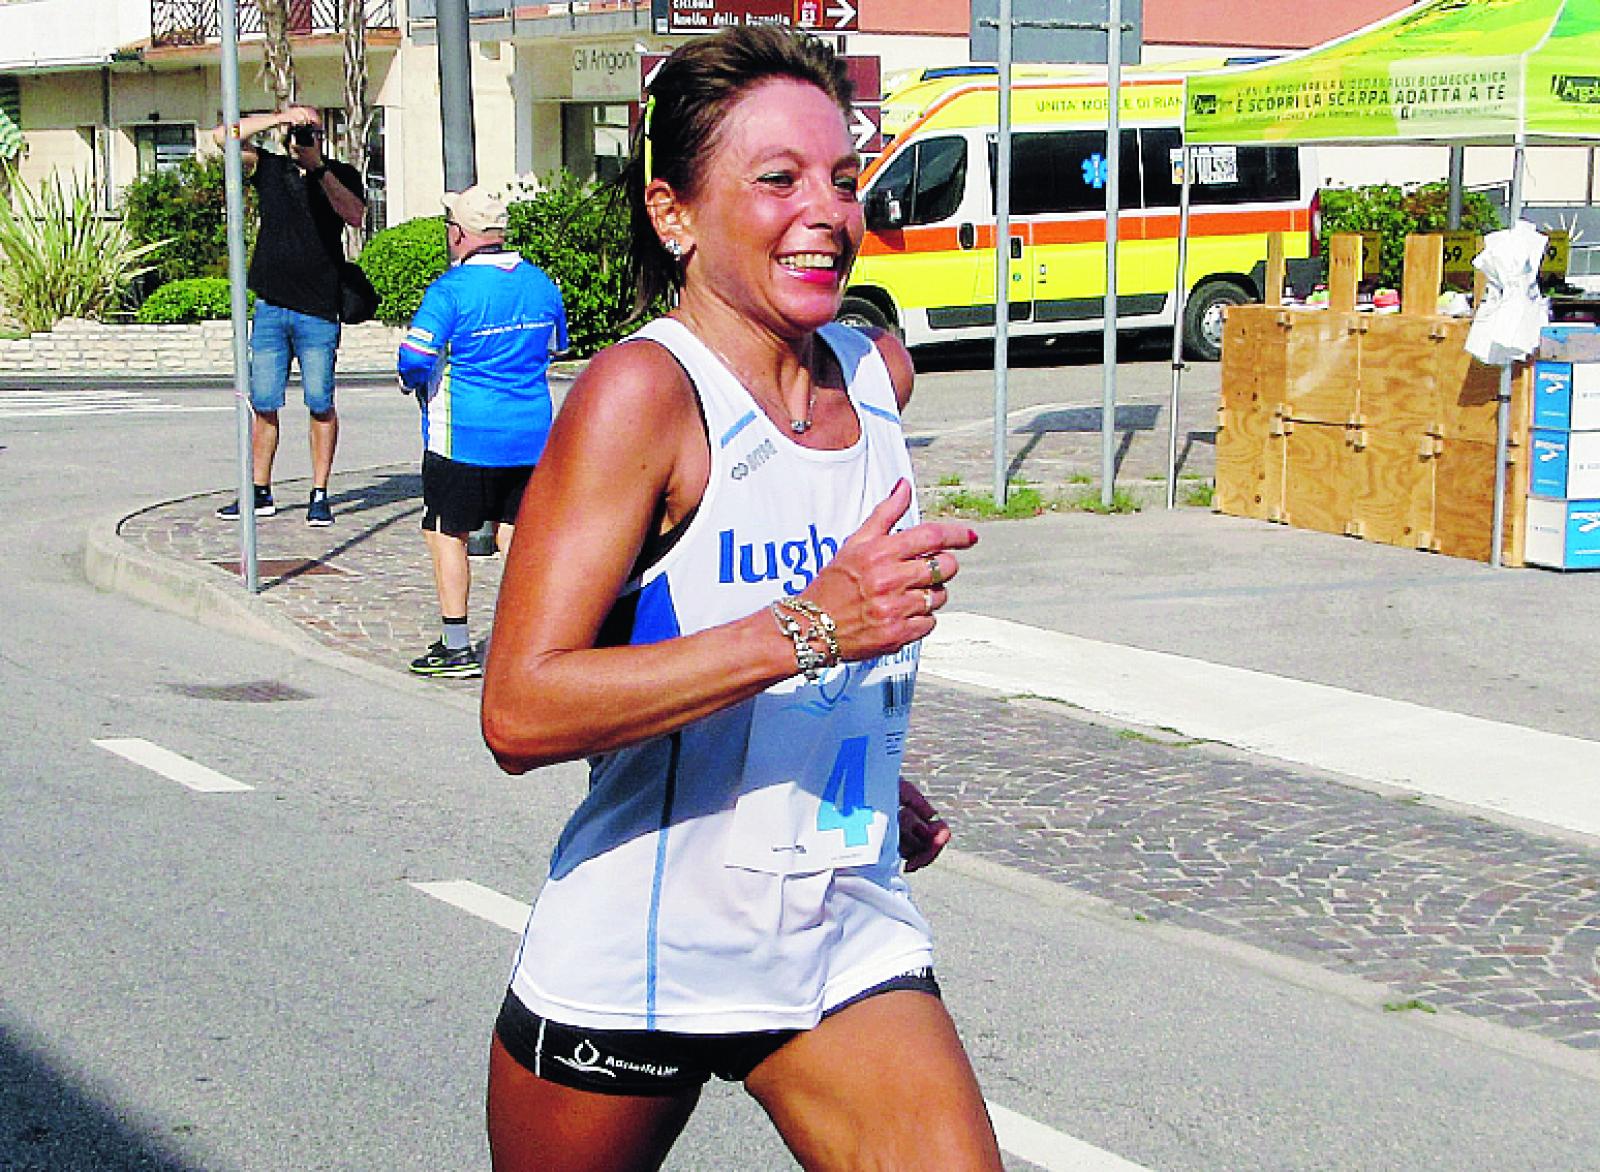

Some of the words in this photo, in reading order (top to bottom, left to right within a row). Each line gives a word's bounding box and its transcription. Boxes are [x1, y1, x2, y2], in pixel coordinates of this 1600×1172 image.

[1247, 94, 1299, 113] SCOPRI
[1304, 92, 1322, 109] LA
[1328, 89, 1389, 107] SCARPA
[1394, 87, 1462, 105] ADATTA
[1469, 86, 1479, 102] A
[1486, 84, 1506, 101] TE
[816, 735, 874, 848] 4
